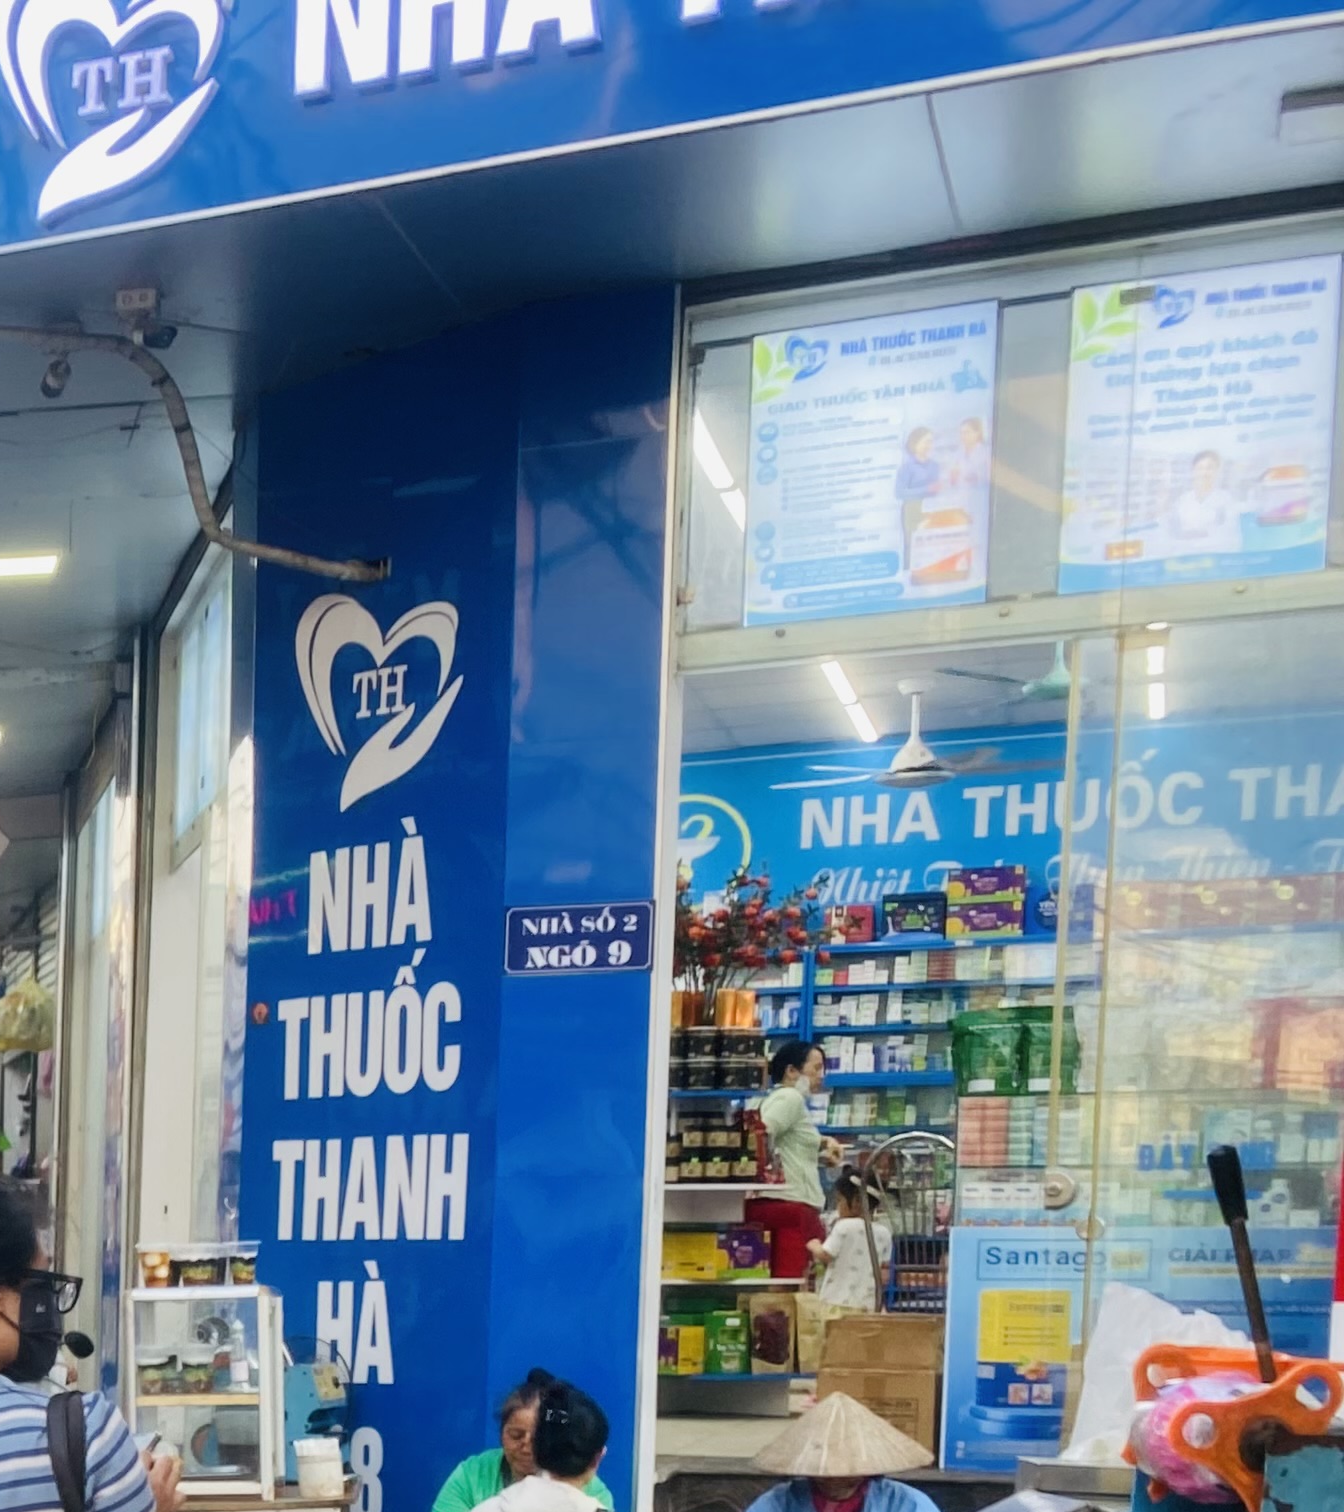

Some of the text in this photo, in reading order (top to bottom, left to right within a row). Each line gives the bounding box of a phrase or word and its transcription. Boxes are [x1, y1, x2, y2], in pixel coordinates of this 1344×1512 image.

[69, 45, 176, 118] TH
[840, 339, 869, 357] NHÀ
[872, 329, 917, 352] THUỐC
[351, 664, 410, 720] TH
[963, 748, 1205, 840] THUỐC
[307, 816, 432, 956] NHÀ
[521, 906, 638, 936] NHÀ SỐ 2
[524, 939, 633, 969] NGÕ 9
[277, 953, 462, 1101] THUỐC
[271, 1132, 469, 1242] THANH
[315, 1259, 396, 1385] HÀ
